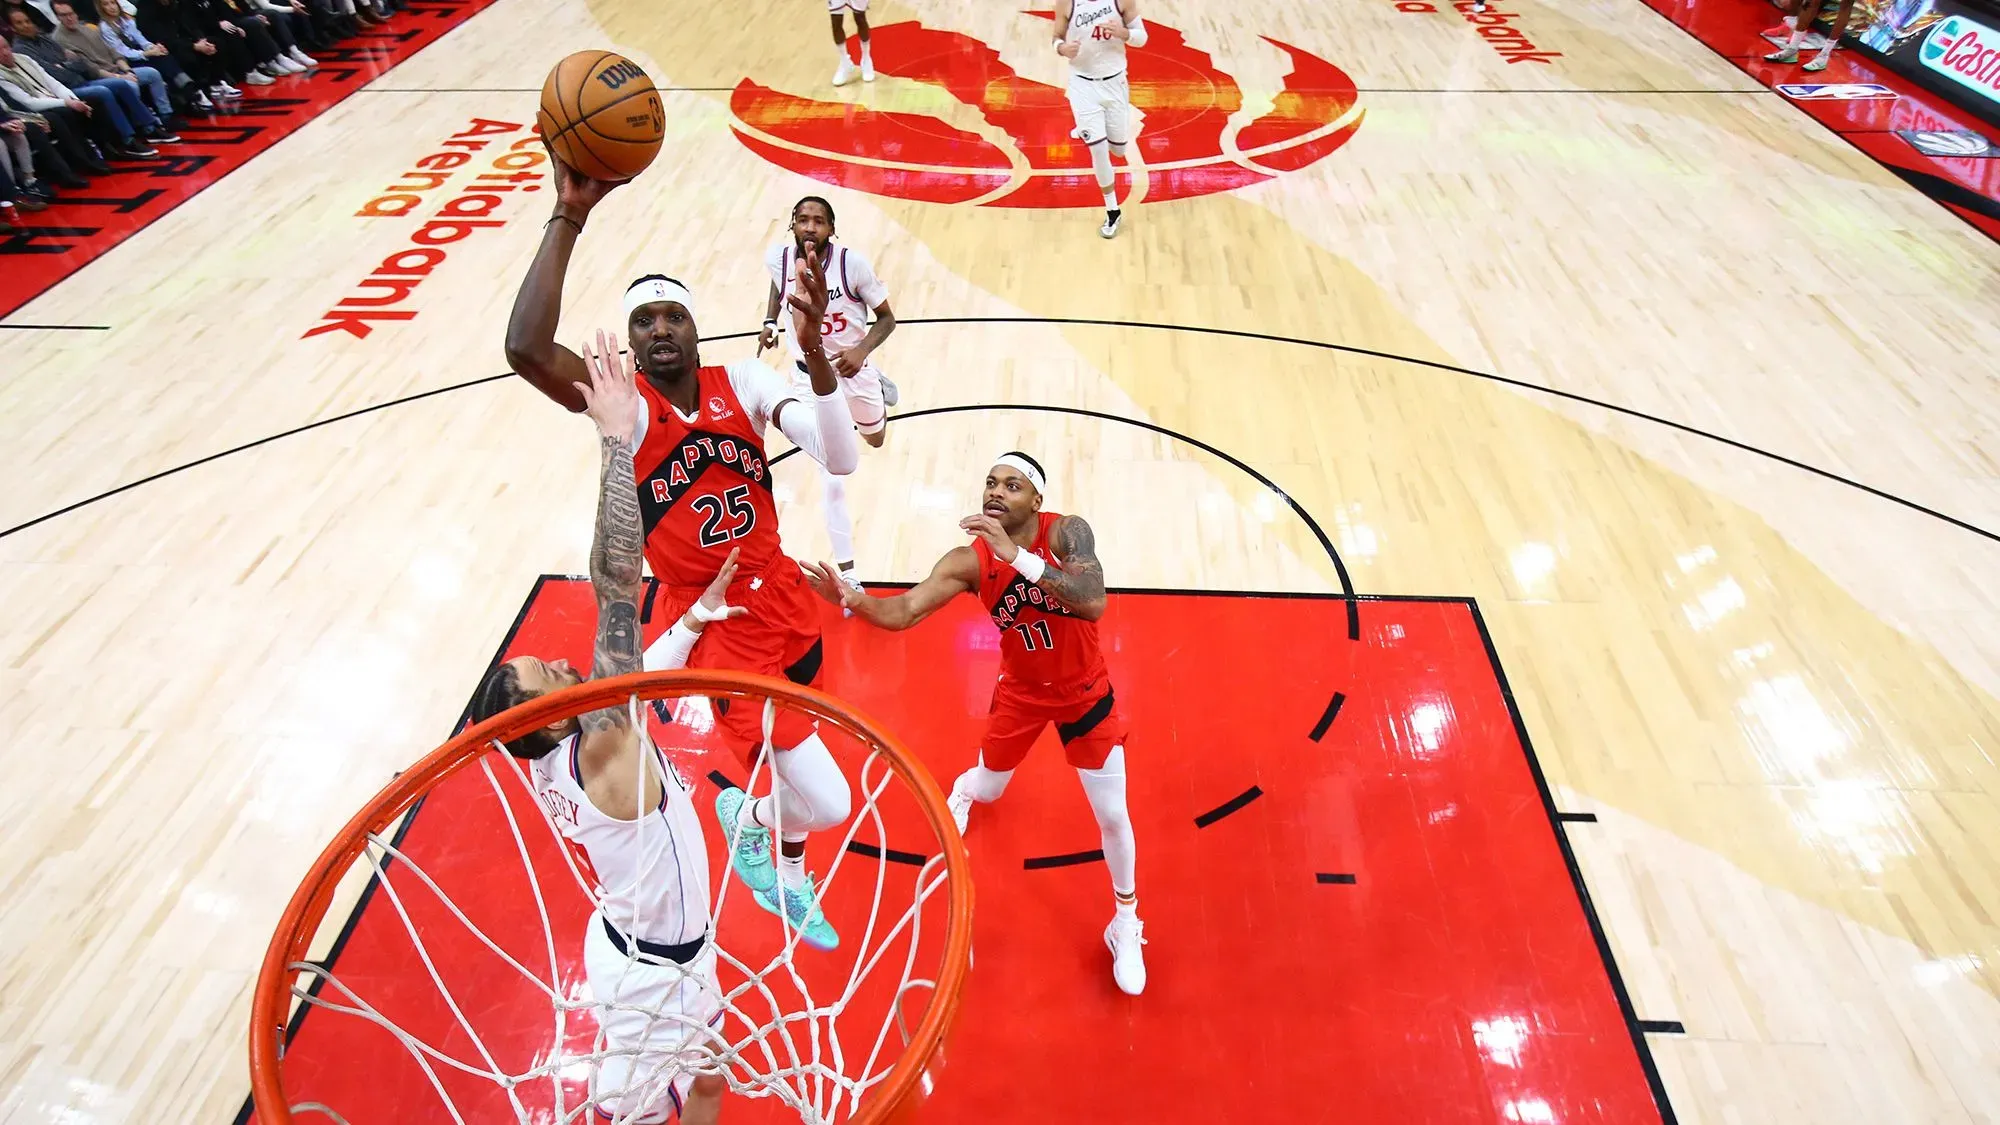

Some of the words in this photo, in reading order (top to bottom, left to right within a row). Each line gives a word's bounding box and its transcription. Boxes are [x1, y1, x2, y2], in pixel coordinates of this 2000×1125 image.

[1075, 5, 1112, 28] Clippers
[1448, 0, 1564, 64] abank
[0, 98, 311, 254] NORTH
[353, 118, 523, 217] Arena
[300, 120, 546, 340] cotiabank
[722, 409, 734, 419] Life
[651, 437, 764, 503] RAPTORS
[690, 483, 756, 548] 25
[1013, 619, 1054, 651] 11
[540, 788, 580, 827] OFFEY
